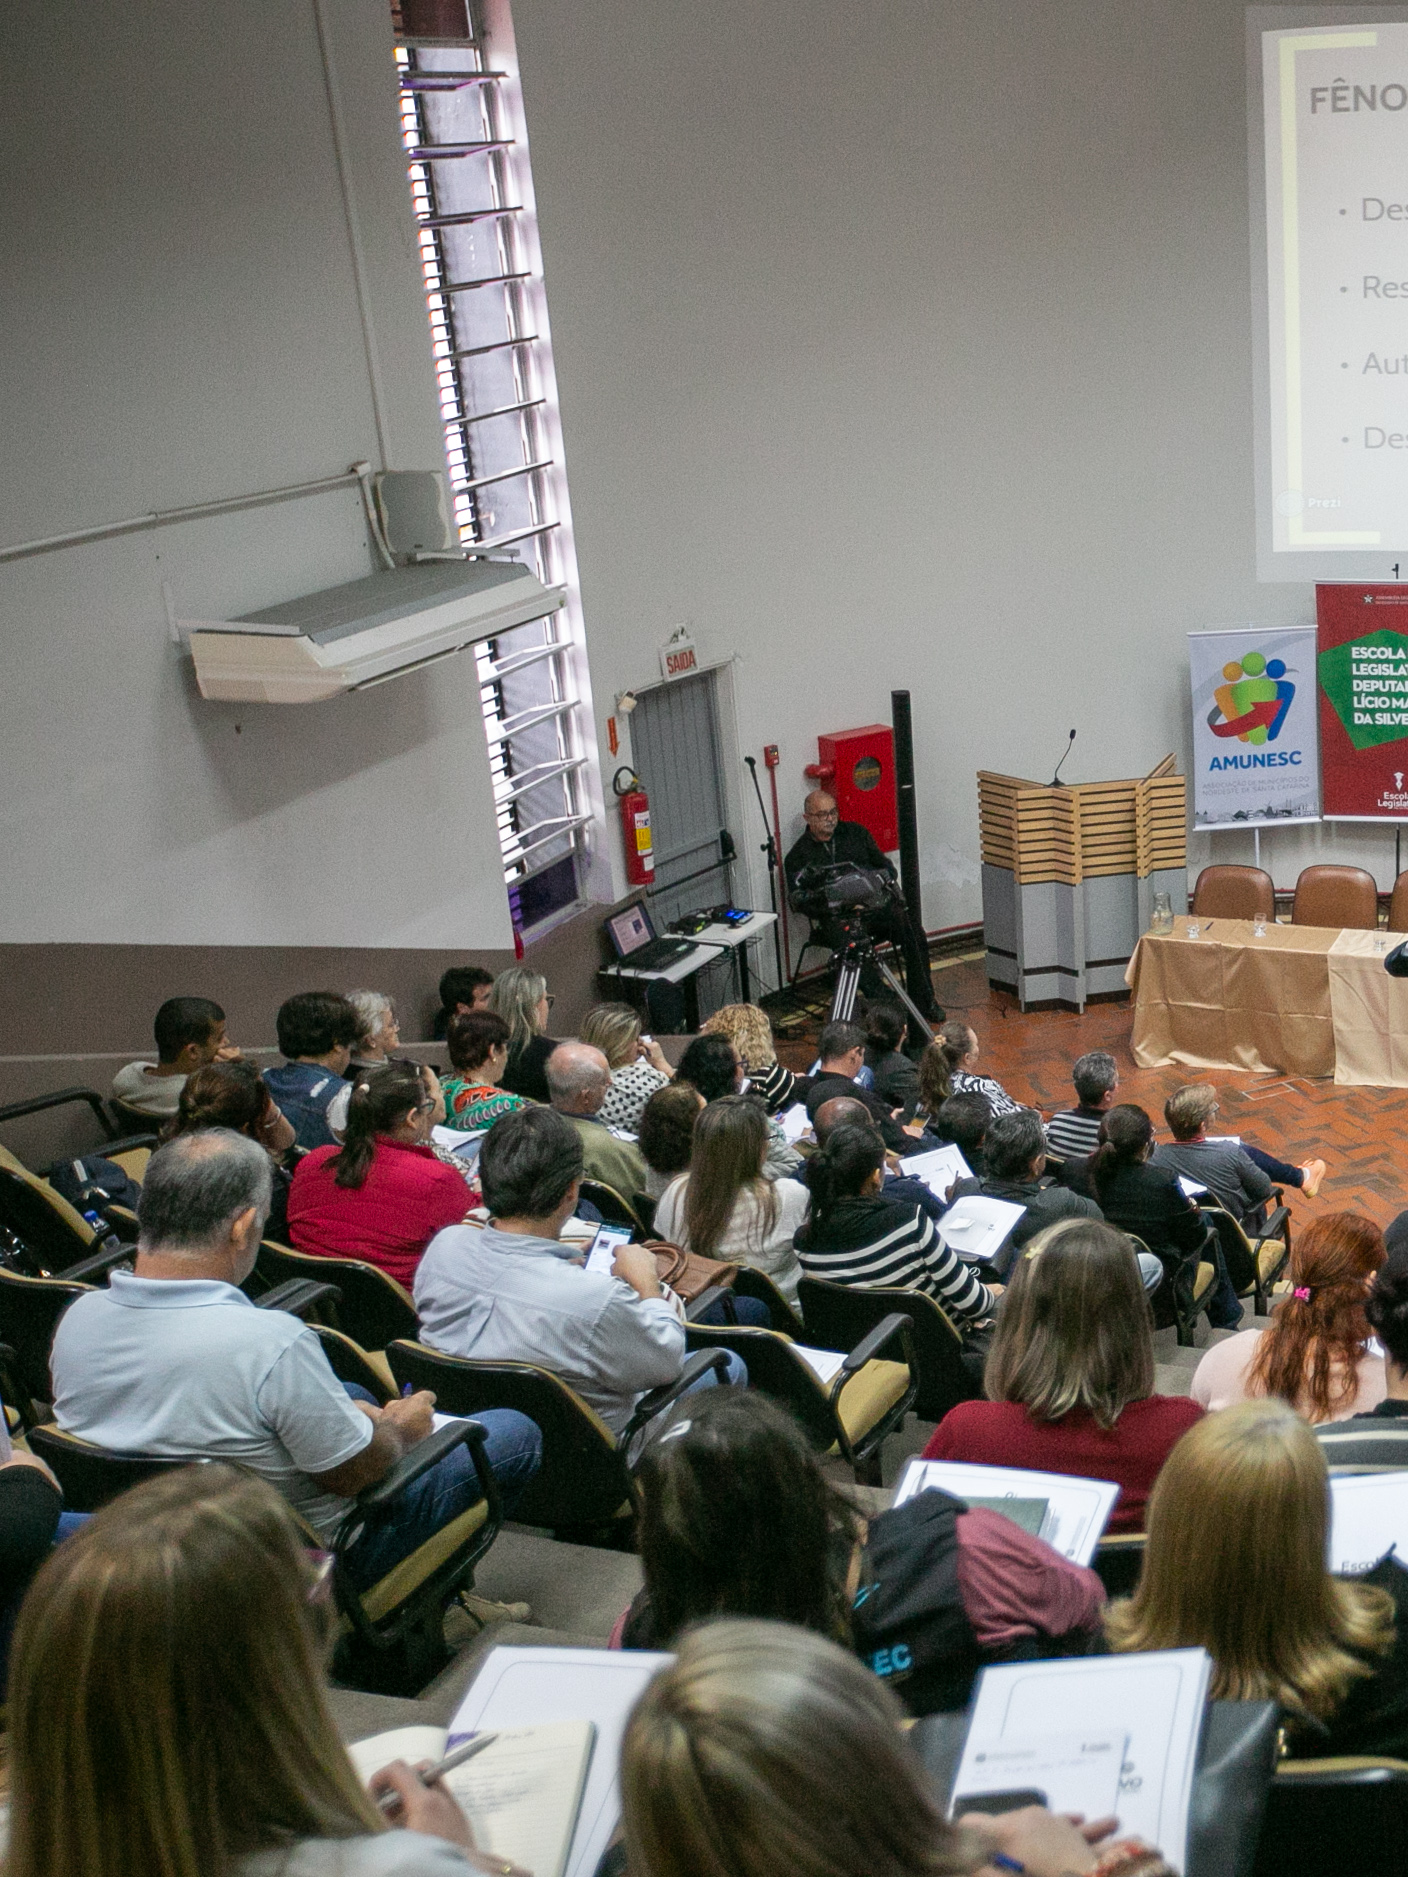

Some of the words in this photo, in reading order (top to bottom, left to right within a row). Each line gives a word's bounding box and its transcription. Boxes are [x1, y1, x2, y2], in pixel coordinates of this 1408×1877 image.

[1307, 496, 1342, 508] Prezi
[1351, 646, 1406, 660] ESCOLA
[1353, 693, 1391, 709] LÍCIO
[1354, 712, 1374, 725] DA
[1209, 750, 1302, 771] AMUNESC
